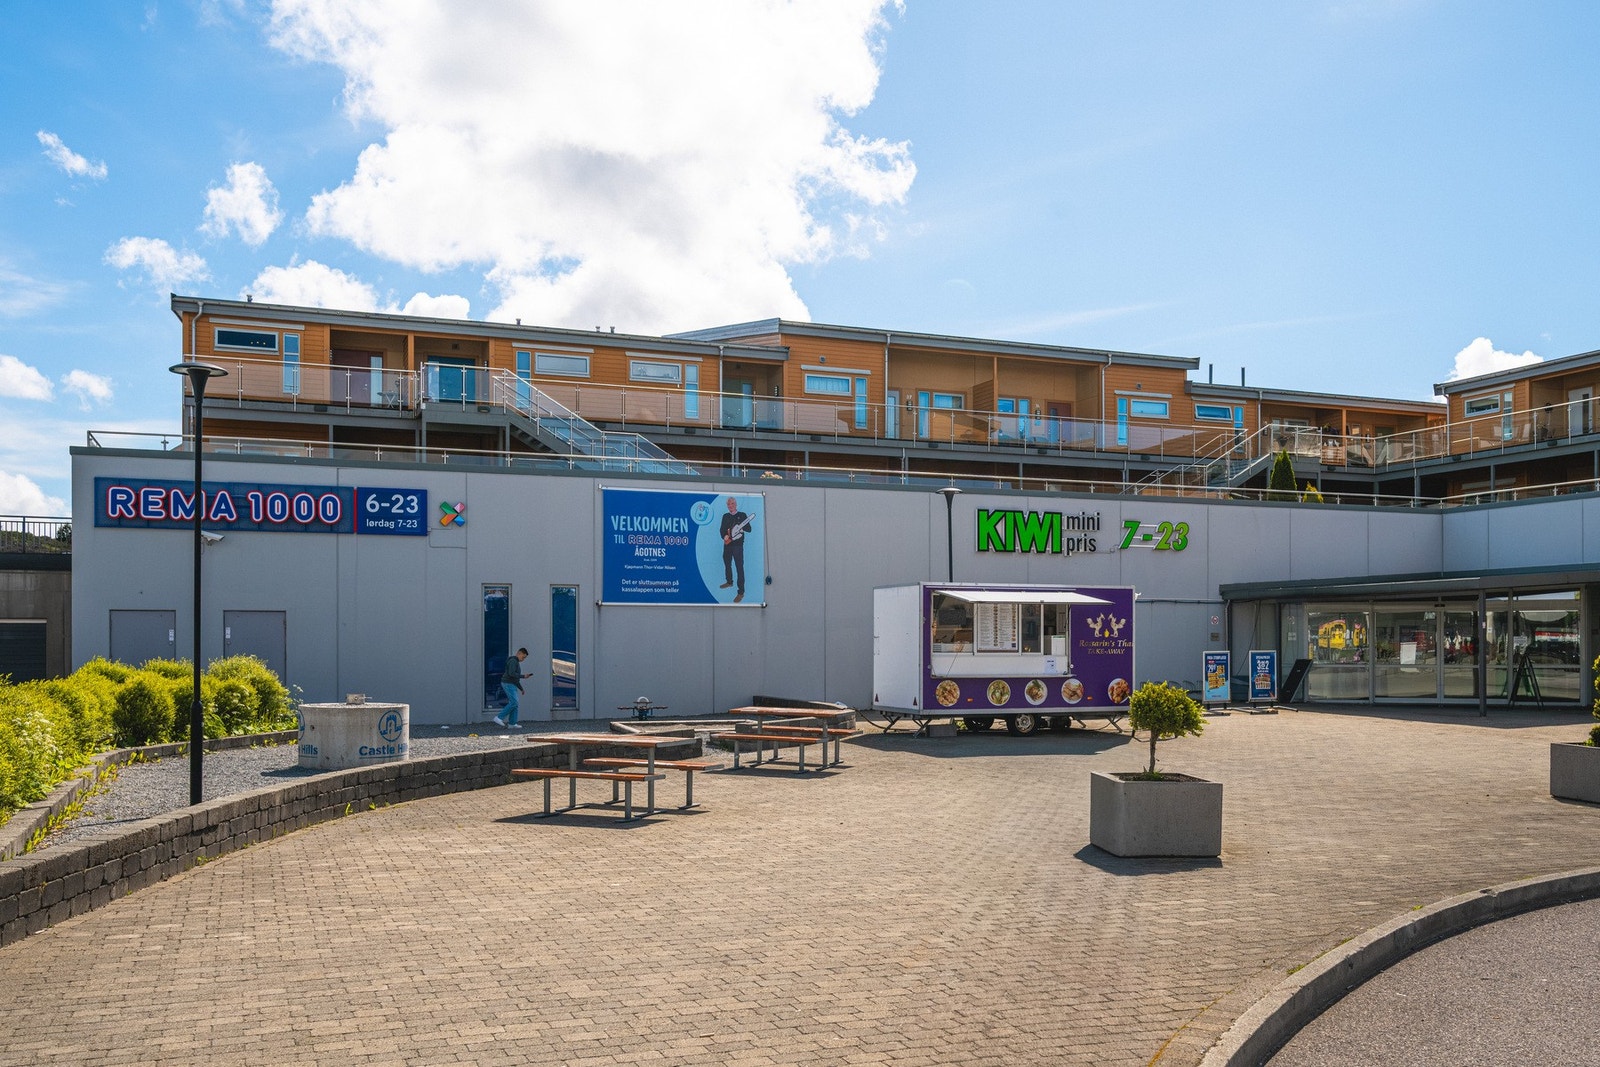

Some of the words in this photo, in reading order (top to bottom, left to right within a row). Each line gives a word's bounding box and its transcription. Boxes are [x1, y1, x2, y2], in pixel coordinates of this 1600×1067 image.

[107, 486, 237, 521] REMA
[247, 491, 342, 524] 1000
[366, 493, 419, 514] 6-23
[366, 518, 395, 529] lørdag
[398, 519, 418, 528] 7-23
[611, 515, 688, 533] VELKOMMEN
[1066, 512, 1100, 531] mini
[614, 534, 625, 544] TIL
[628, 534, 661, 545] REMA
[664, 536, 688, 545] 1000
[977, 509, 1063, 554] KIWI
[1120, 520, 1190, 551] 7-23
[634, 545, 666, 557] ÅGOTNES
[1067, 535, 1097, 556] pris
[301, 744, 318, 755] Hills
[359, 745, 395, 756] Castle
